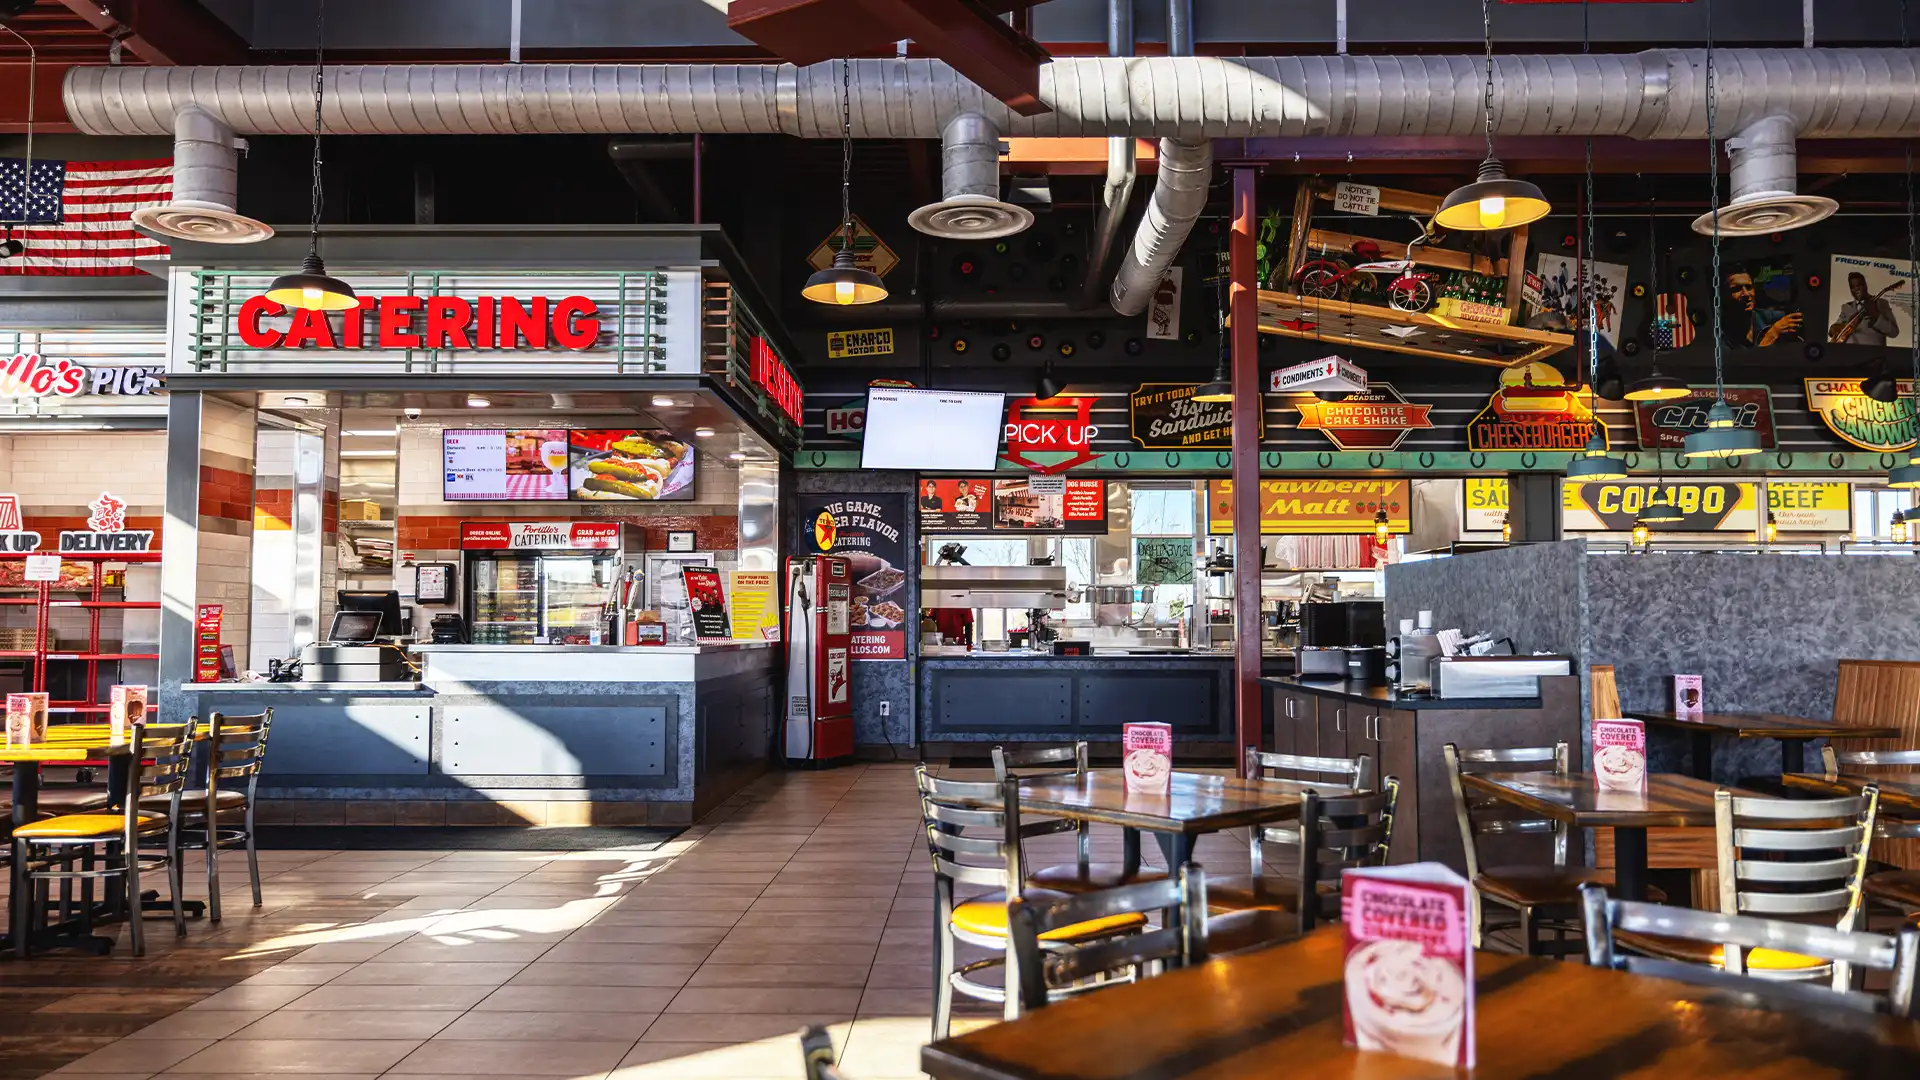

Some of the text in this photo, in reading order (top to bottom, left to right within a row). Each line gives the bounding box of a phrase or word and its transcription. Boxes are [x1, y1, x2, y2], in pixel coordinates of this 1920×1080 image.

[1344, 186, 1372, 195] NOTICE
[1350, 194, 1364, 202] NOT
[1342, 202, 1370, 211] CATTLE
[1834, 257, 1896, 270] FREDDY KING
[237, 294, 601, 350] CATERING
[848, 345, 891, 355] MOTOR OIL
[1282, 367, 1324, 386] CONDIMENTS
[1341, 367, 1362, 385] CONDIMENTS
[1134, 386, 1197, 407] TRY IT TODAY
[1326, 407, 1404, 416] CHOCOLATE
[1652, 403, 1760, 428] Chli
[1843, 396, 1916, 423] CHICKEN
[831, 411, 864, 431] HO
[1149, 406, 1233, 438] Sandwic
[1324, 416, 1407, 425] CAKE SHAKE
[1830, 408, 1919, 445] SANDWIC
[1004, 423, 1099, 446] PICK UP
[1182, 432, 1201, 445] AND
[1203, 429, 1221, 441] GET
[1477, 424, 1597, 449] CHEESEBURGERS
[1660, 433, 1686, 443] SPEA
[1216, 479, 1401, 497] Srawberry
[1472, 489, 1509, 507] SAU
[1766, 490, 1824, 508] BEEF
[846, 501, 883, 518] GAME.
[1015, 508, 1034, 518] HOUSE
[1265, 499, 1351, 515] Malt
[523, 525, 560, 534] Portillo's
[851, 516, 900, 544] FLAVOR.
[12, 534, 38, 551] UP
[61, 533, 151, 551] DELIVERY
[514, 534, 567, 547] CATERING
[851, 635, 886, 644] ATERING
[851, 645, 891, 654] LLOS.COM
[1131, 736, 1164, 744] COVERED
[1600, 733, 1637, 741] COVERED
